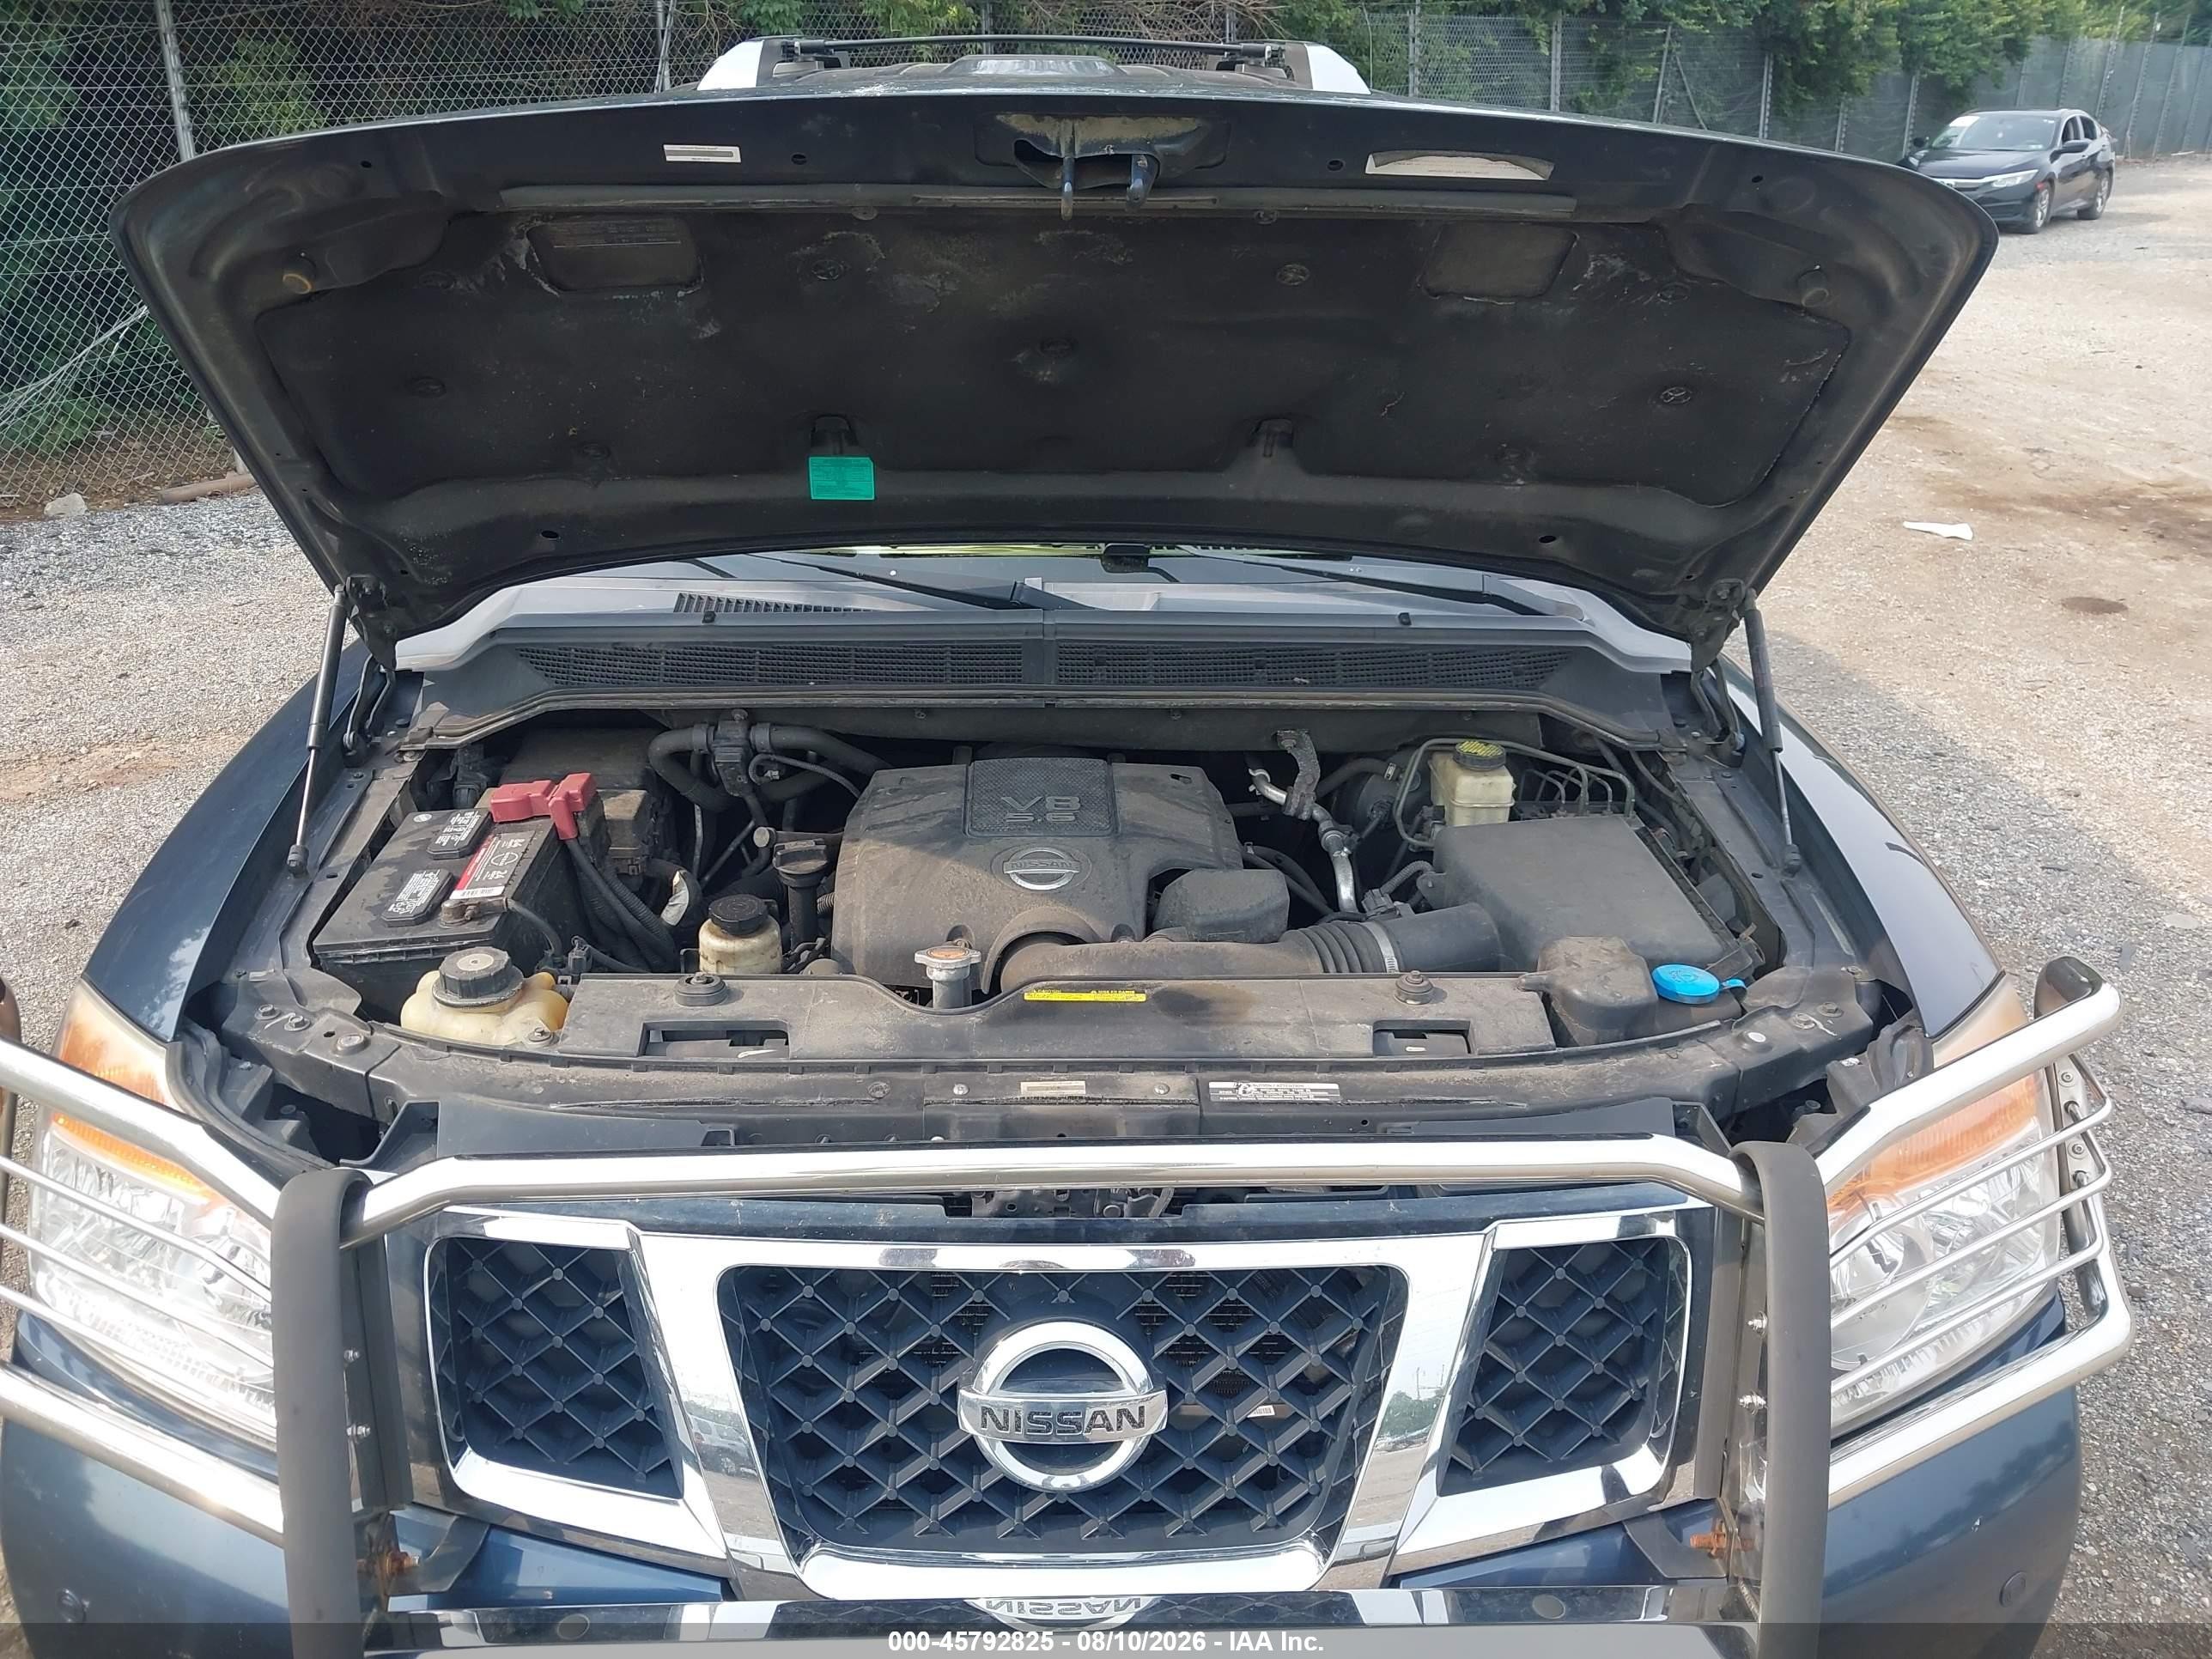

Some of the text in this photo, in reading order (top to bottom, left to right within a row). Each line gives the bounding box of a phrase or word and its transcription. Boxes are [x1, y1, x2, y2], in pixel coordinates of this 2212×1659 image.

[1001, 795, 1081, 811] V8
[1005, 812, 1076, 823] 5.6
[1011, 860, 1073, 869] NISSAN
[981, 1406, 1146, 1436] NISSAN
